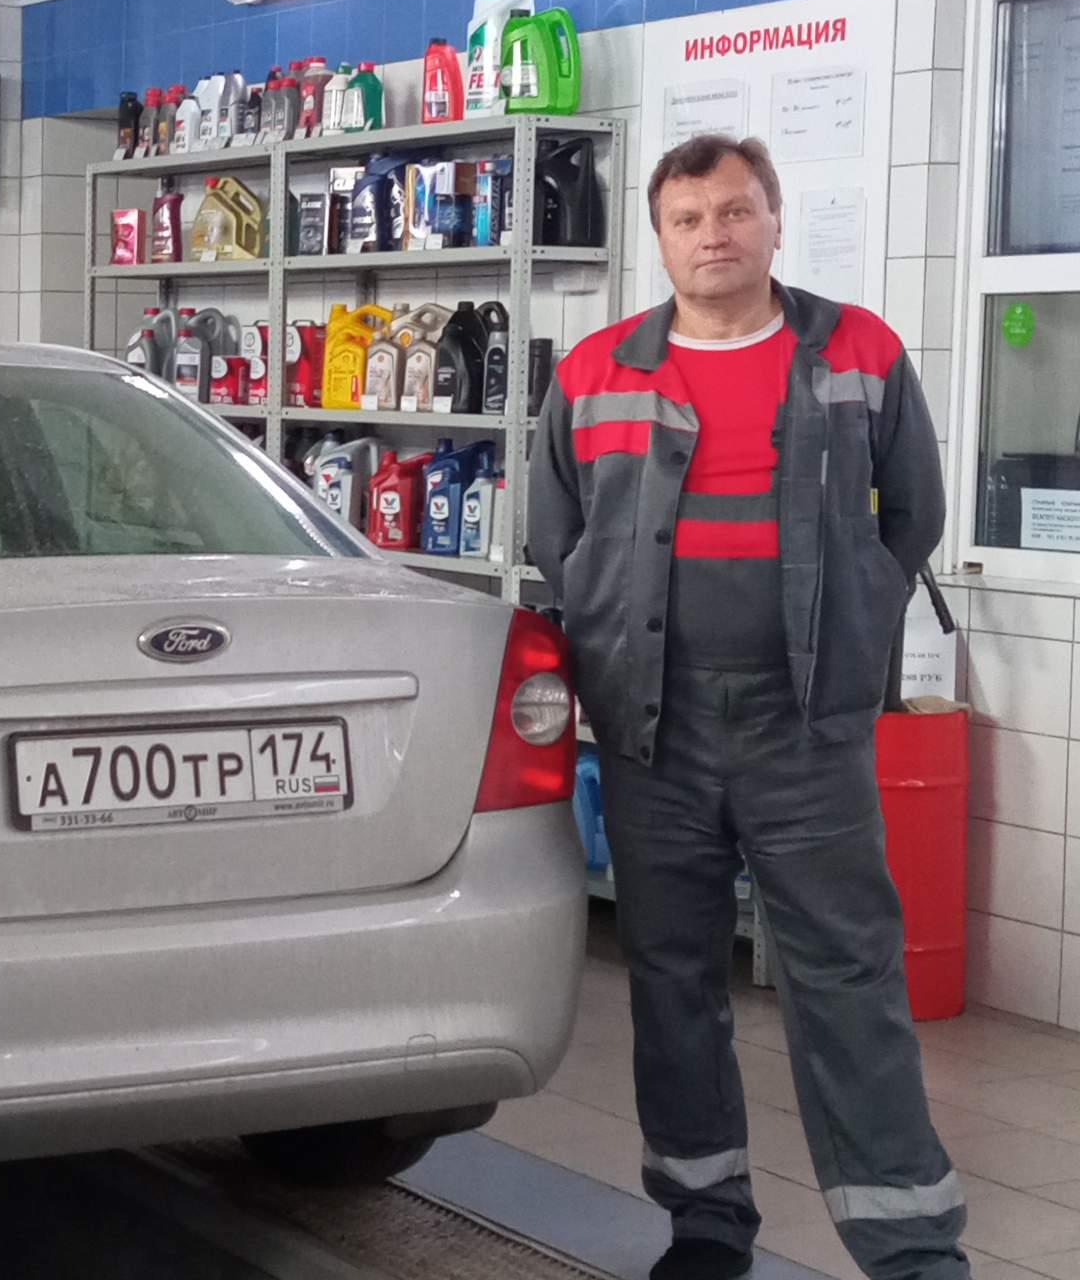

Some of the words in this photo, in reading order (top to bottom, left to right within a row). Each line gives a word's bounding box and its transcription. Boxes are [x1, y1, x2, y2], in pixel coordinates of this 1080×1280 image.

[684, 17, 847, 62] ИНФОРМАЦИЯ
[163, 628, 212, 653] Ford
[258, 731, 333, 776] 174
[275, 778, 312, 795] RUS
